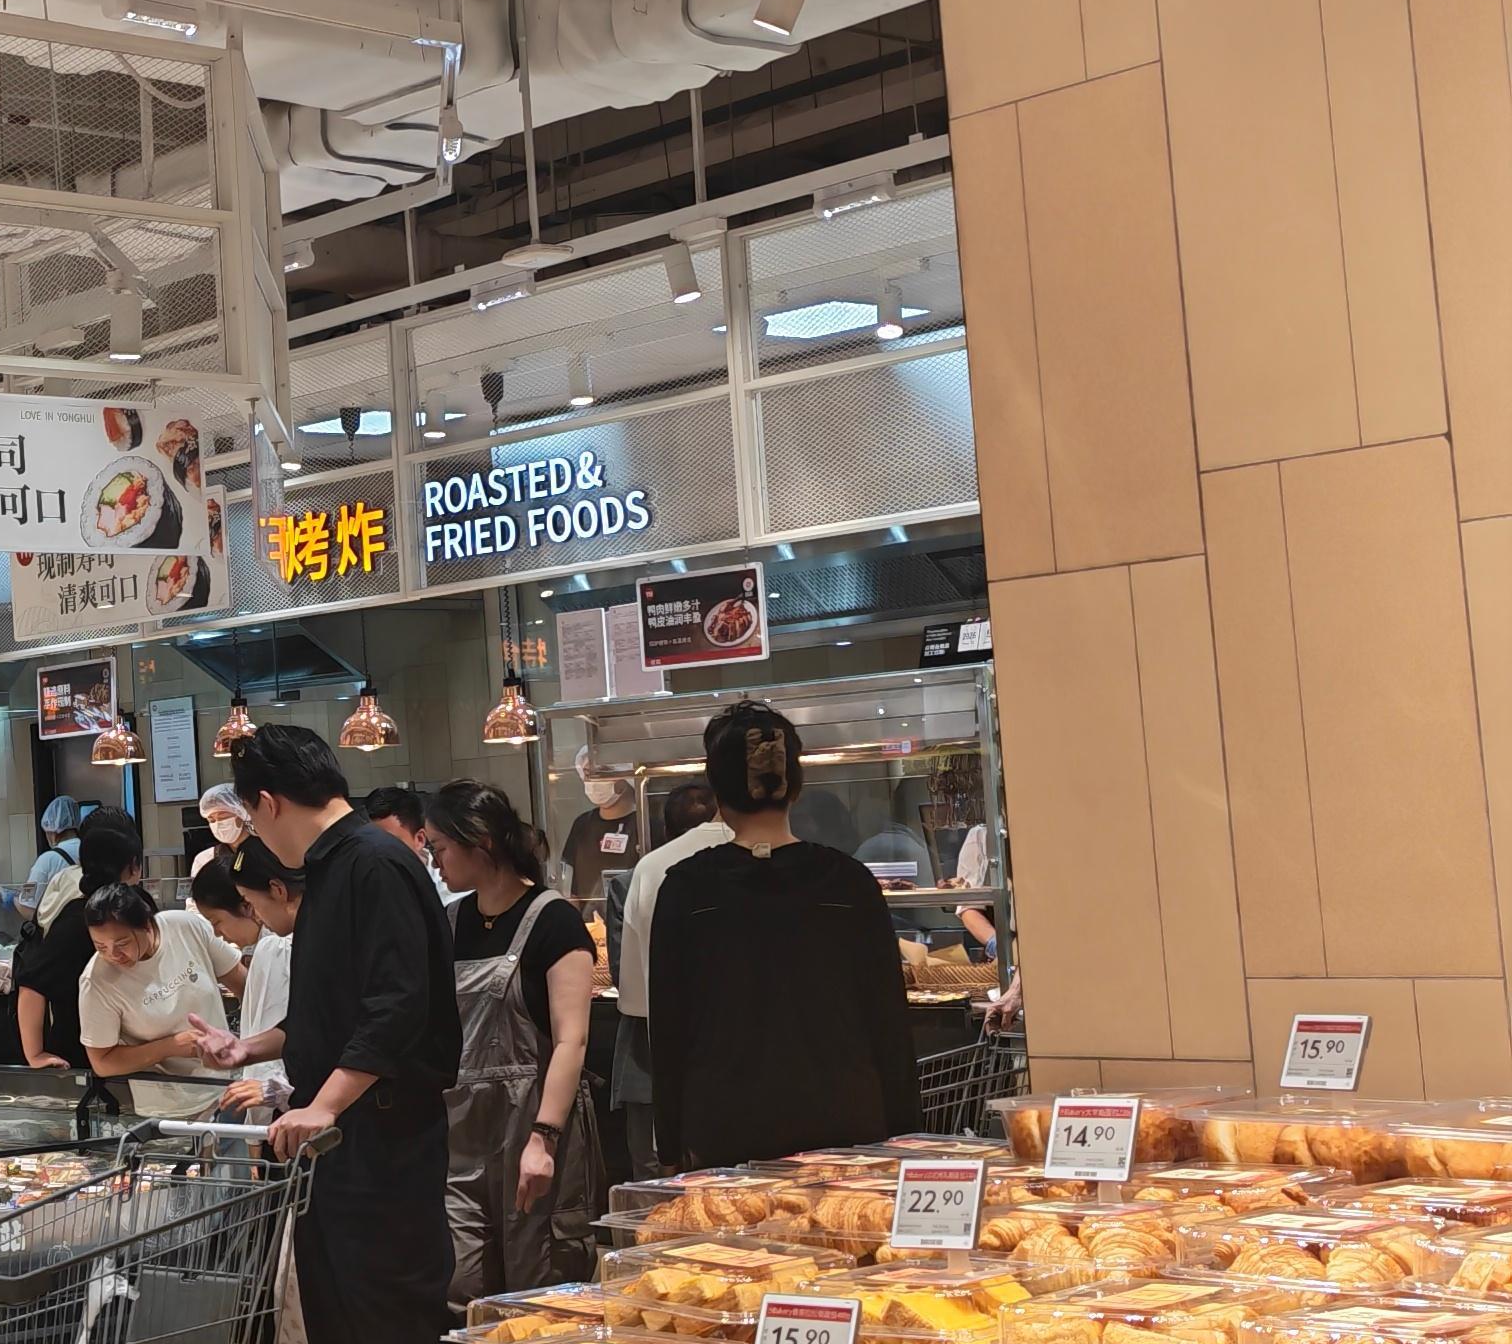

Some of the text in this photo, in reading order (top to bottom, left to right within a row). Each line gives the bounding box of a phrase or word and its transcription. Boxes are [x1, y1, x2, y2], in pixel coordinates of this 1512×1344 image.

[20, 410, 95, 423] LOVE IN YONGHUI
[425, 490, 650, 562] FRIED FOODS
[284, 502, 386, 582] 烤炸
[57, 574, 138, 615] 清爽可口
[1300, 1039, 1345, 1059] 15.90
[1064, 1125, 1115, 1147] 14.90
[908, 1190, 964, 1213] 22.90
